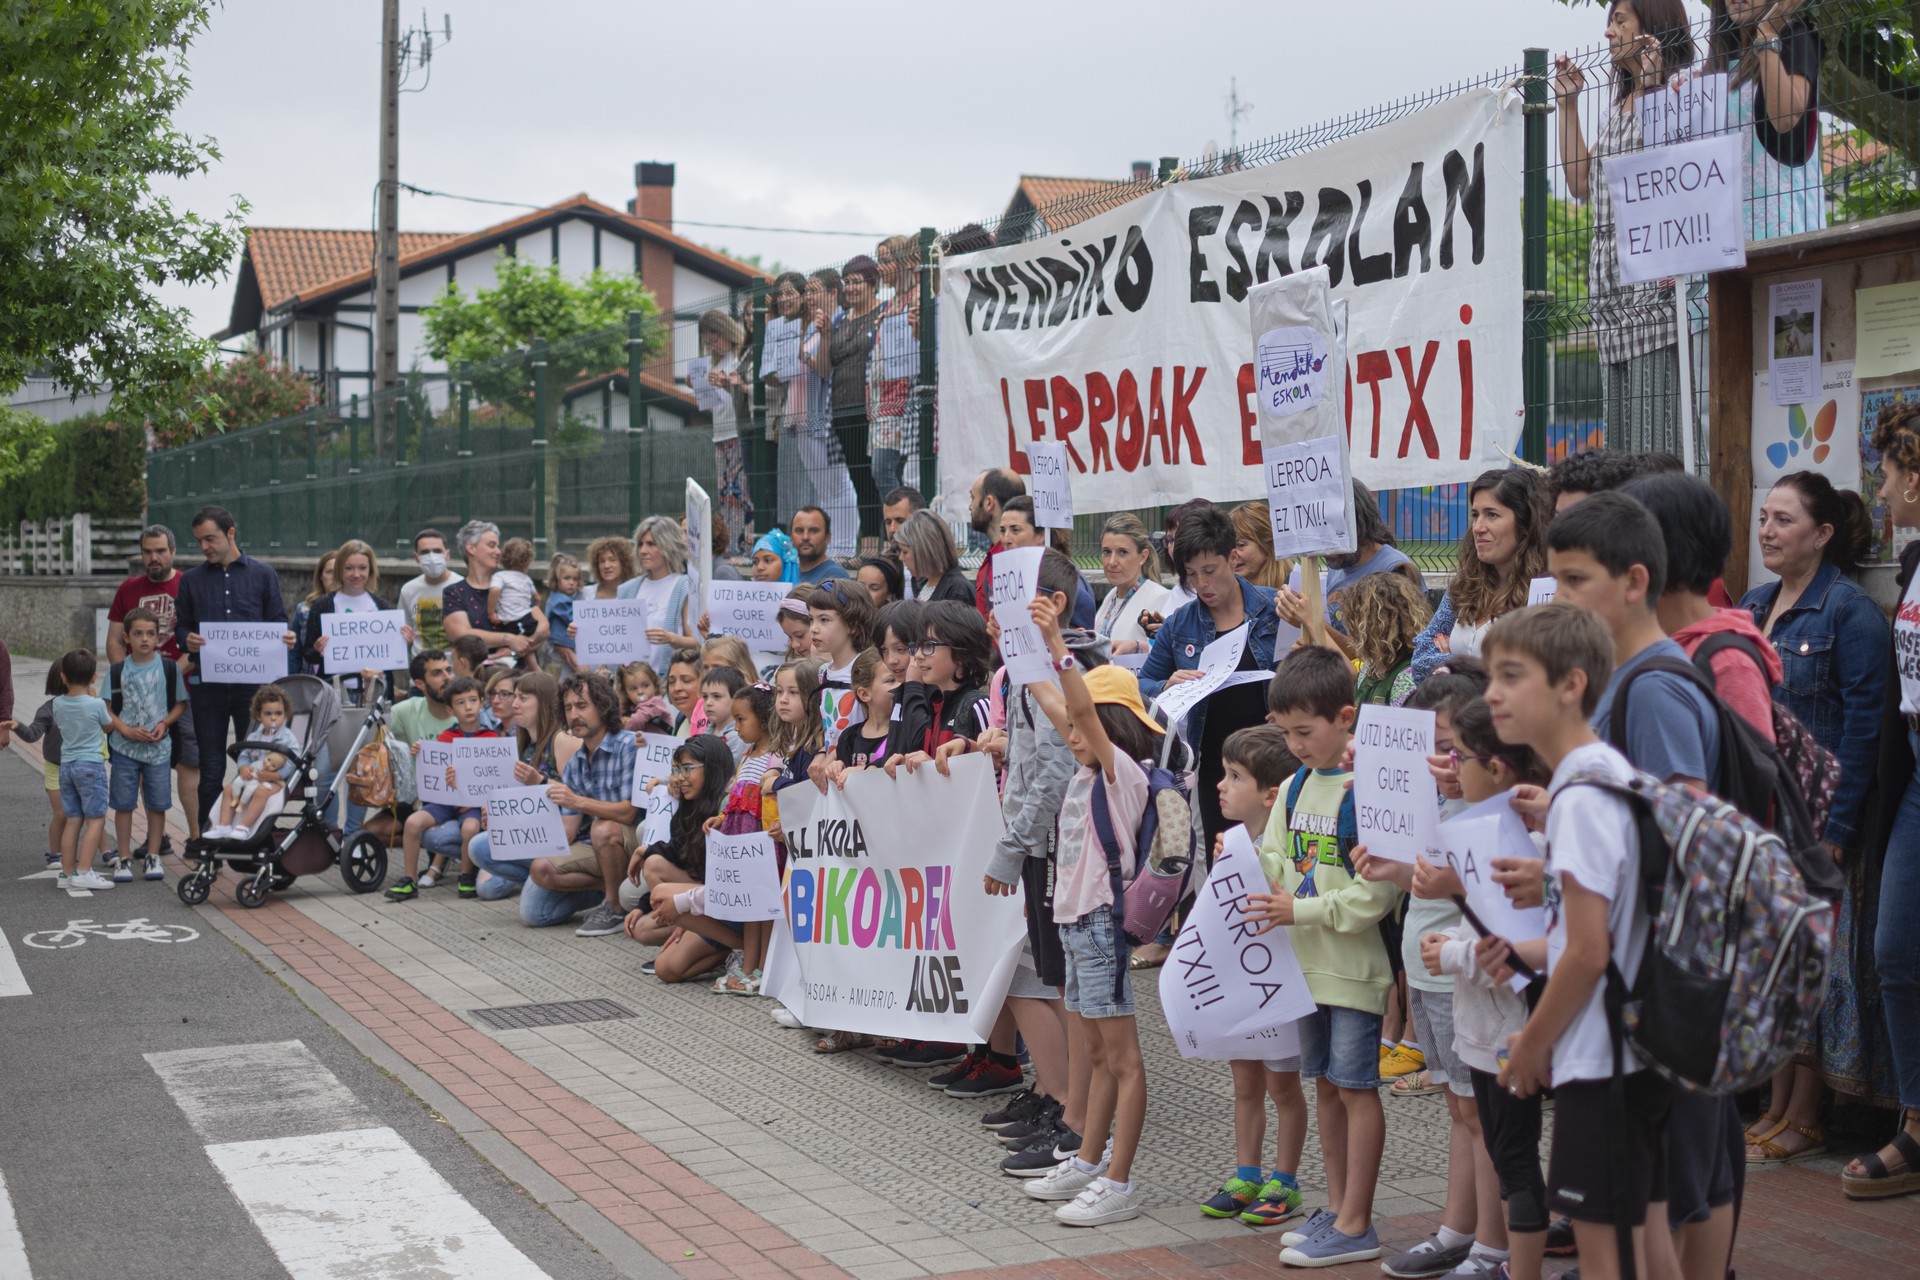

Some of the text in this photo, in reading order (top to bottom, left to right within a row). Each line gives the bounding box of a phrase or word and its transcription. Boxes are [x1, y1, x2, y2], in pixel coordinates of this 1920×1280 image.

[1623, 158, 1726, 203] LERROA
[1189, 141, 1485, 304] ESKOLAN
[1628, 212, 1712, 256] EZ ITXI!!
[1260, 349, 1328, 391] Mendiko
[1272, 382, 1311, 408] ESKOLA
[1001, 365, 1207, 474] LERROAK
[1033, 455, 1061, 476] LERROA
[1270, 455, 1332, 489] LERROA
[1275, 501, 1328, 533] EZ ITXI!!
[714, 589, 783, 602] UTZI BAKEAN
[994, 570, 1026, 605] ERROA
[579, 606, 641, 619] UTZI BAKEAN
[732, 609, 765, 621] GURE
[207, 630, 280, 640] UTZI BAKEAN
[331, 619, 397, 637] LERROA
[598, 625, 627, 636] GURE
[227, 646, 260, 657] GURE
[332, 644, 390, 661] EZ ITXI!!
[588, 642, 633, 654] ESKOLA!!
[1004, 628, 1017, 658] EZ
[214, 663, 265, 674] ESKOLA!!
[1360, 723, 1427, 752] UTZI BAKEAN
[455, 746, 511, 759] UTZI BAKEAN
[473, 766, 500, 778] GURE
[1377, 766, 1410, 794] GURE
[423, 775, 440, 791] EZ
[488, 797, 550, 816] LERROA
[1360, 805, 1414, 837] ESKOLA!!
[491, 827, 548, 846] EZ ITXI!!
[715, 867, 741, 884] GURE
[906, 955, 969, 1014] ALDE
